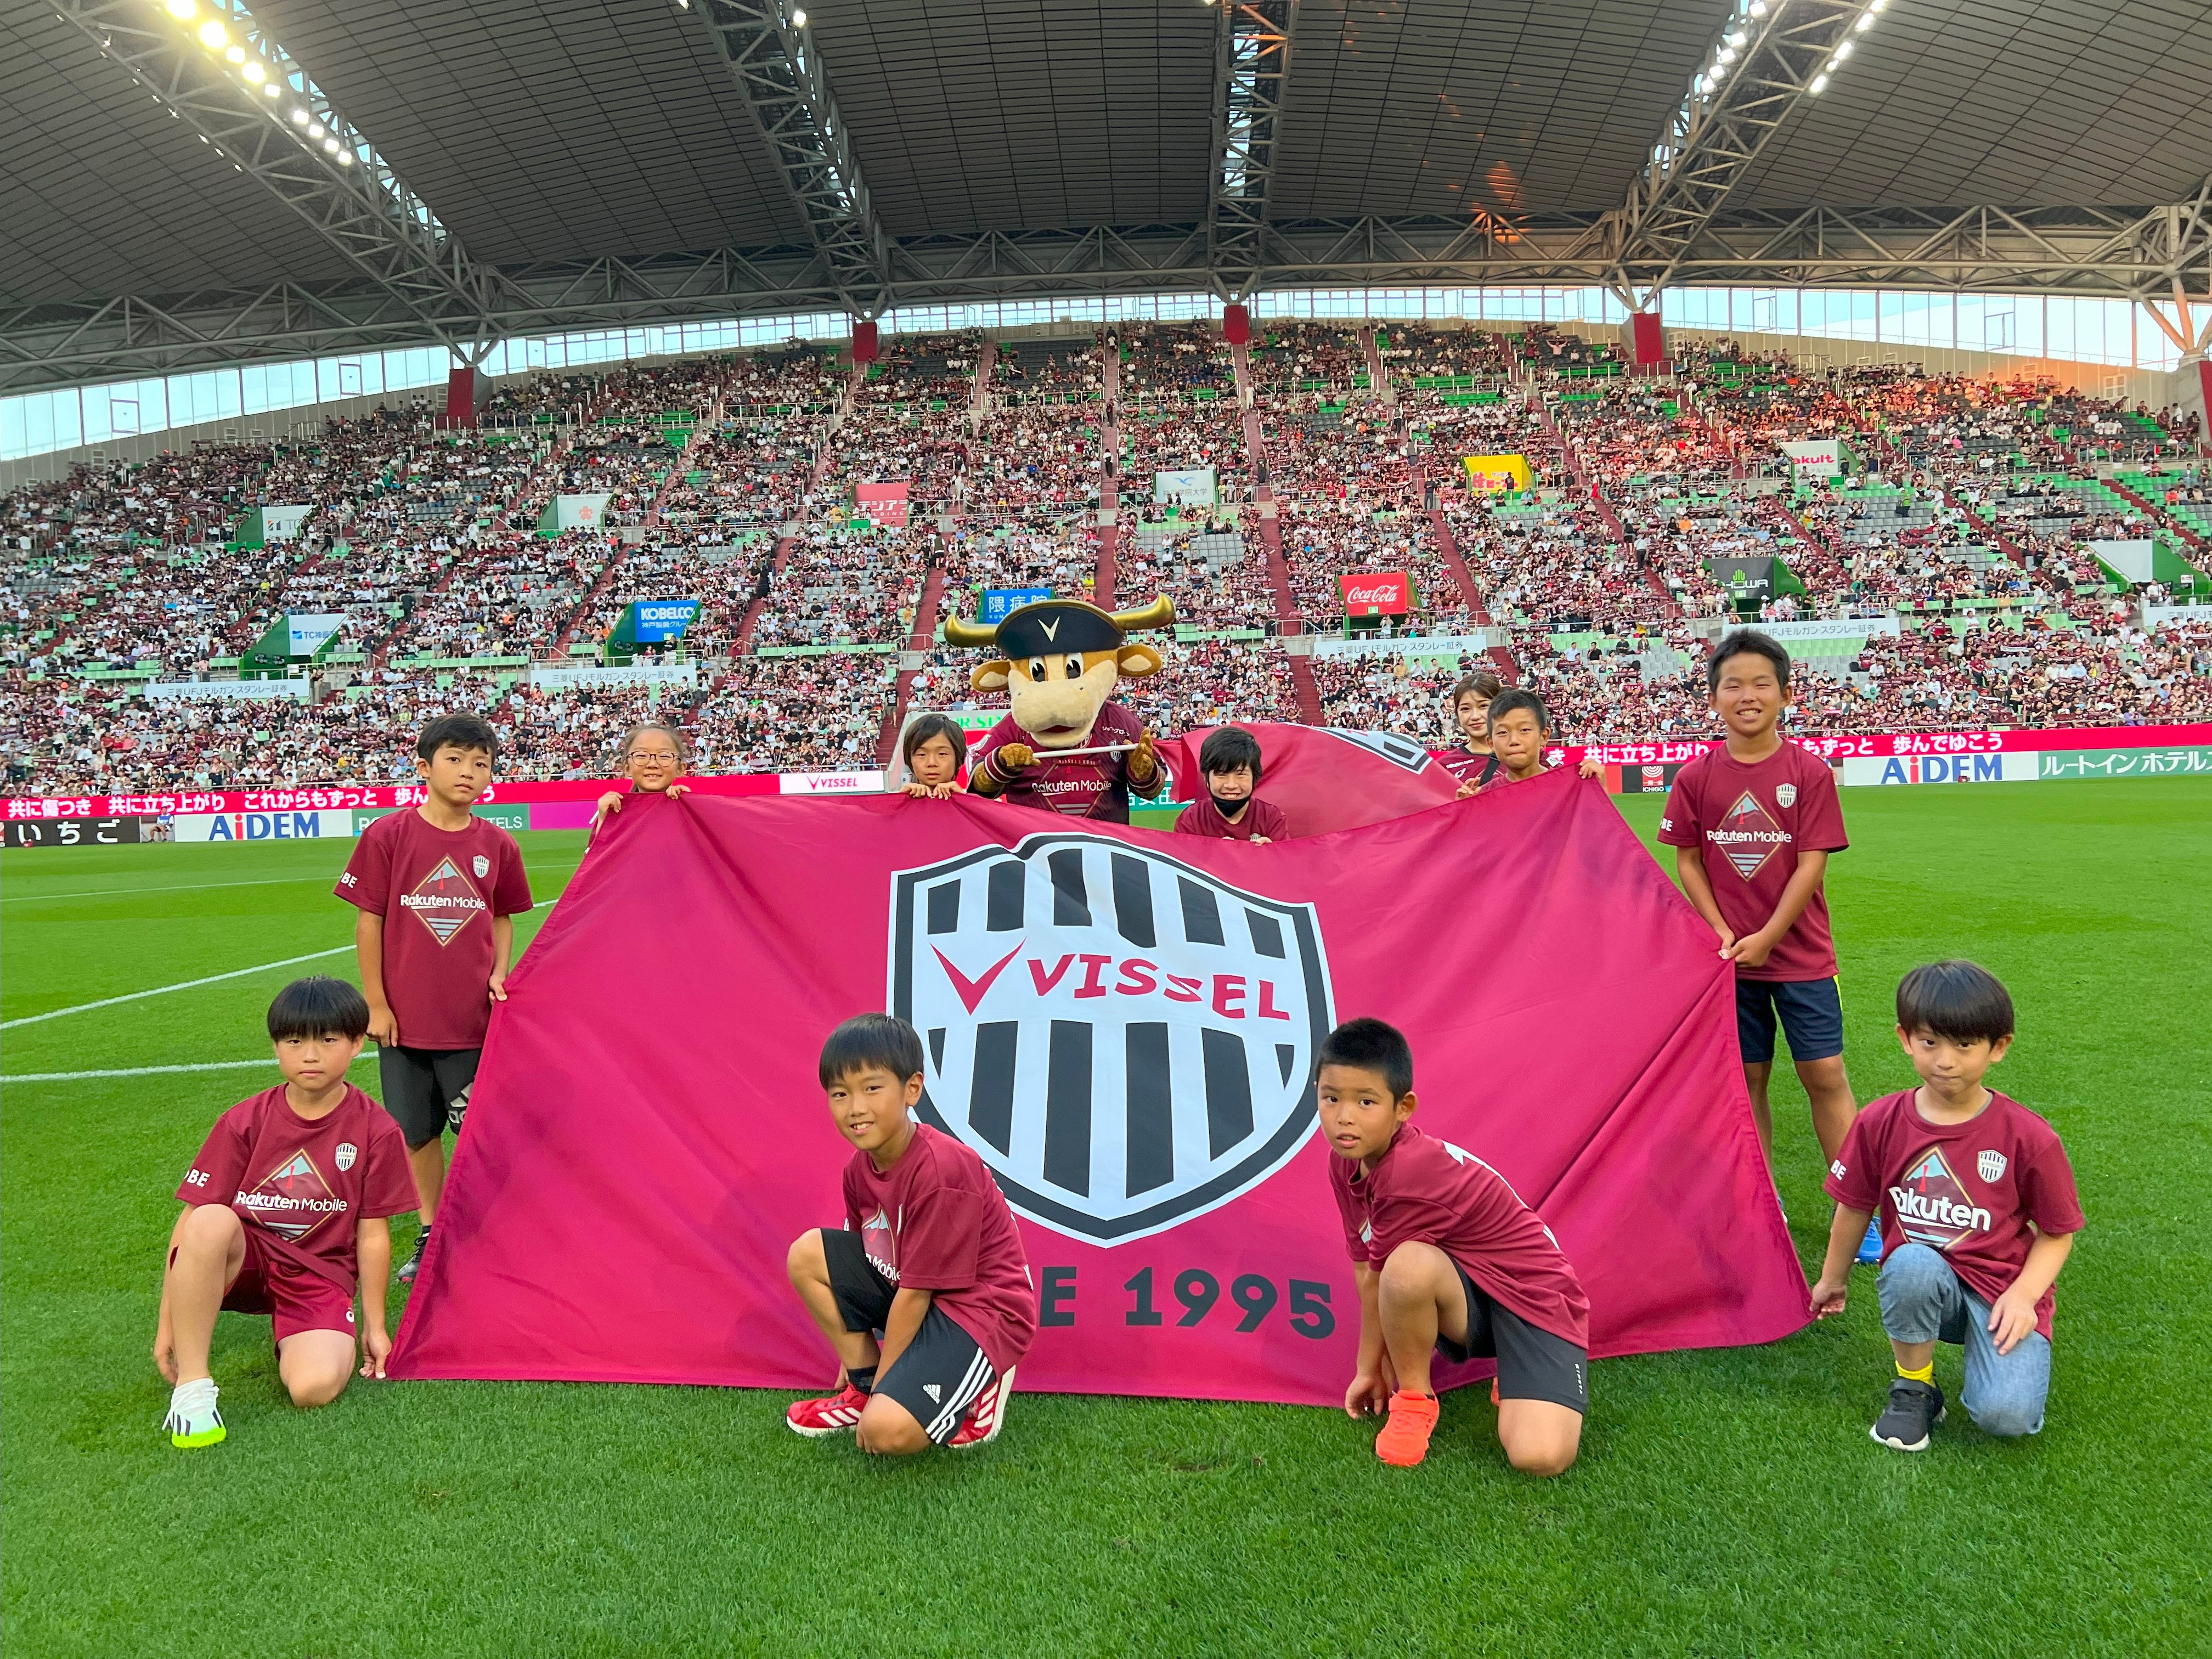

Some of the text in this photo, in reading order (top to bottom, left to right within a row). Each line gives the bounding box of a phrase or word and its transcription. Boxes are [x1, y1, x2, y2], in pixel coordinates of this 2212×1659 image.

[1791, 454, 1835, 465] akult
[641, 606, 695, 620] KOBELCO
[1893, 733, 2003, 754] 歩んでゆこう
[1881, 754, 2002, 785] AiDEM
[1032, 780, 1112, 793] Rakuten Mobile
[8, 785, 495, 818] 共に傷つき 共に立ち上がり これからもずっと 歩んう
[18, 819, 120, 845] いちご
[208, 811, 320, 840] AiDEM
[1660, 817, 1673, 832] BE
[1706, 829, 1792, 843] Rakuten Mobile
[341, 871, 358, 888] BE
[400, 894, 486, 911] Rakuten Mobile
[1027, 953, 1290, 1020] VISSEL
[235, 1190, 348, 1212] Rakuten Mobile
[1123, 1266, 1336, 1340] 1995
